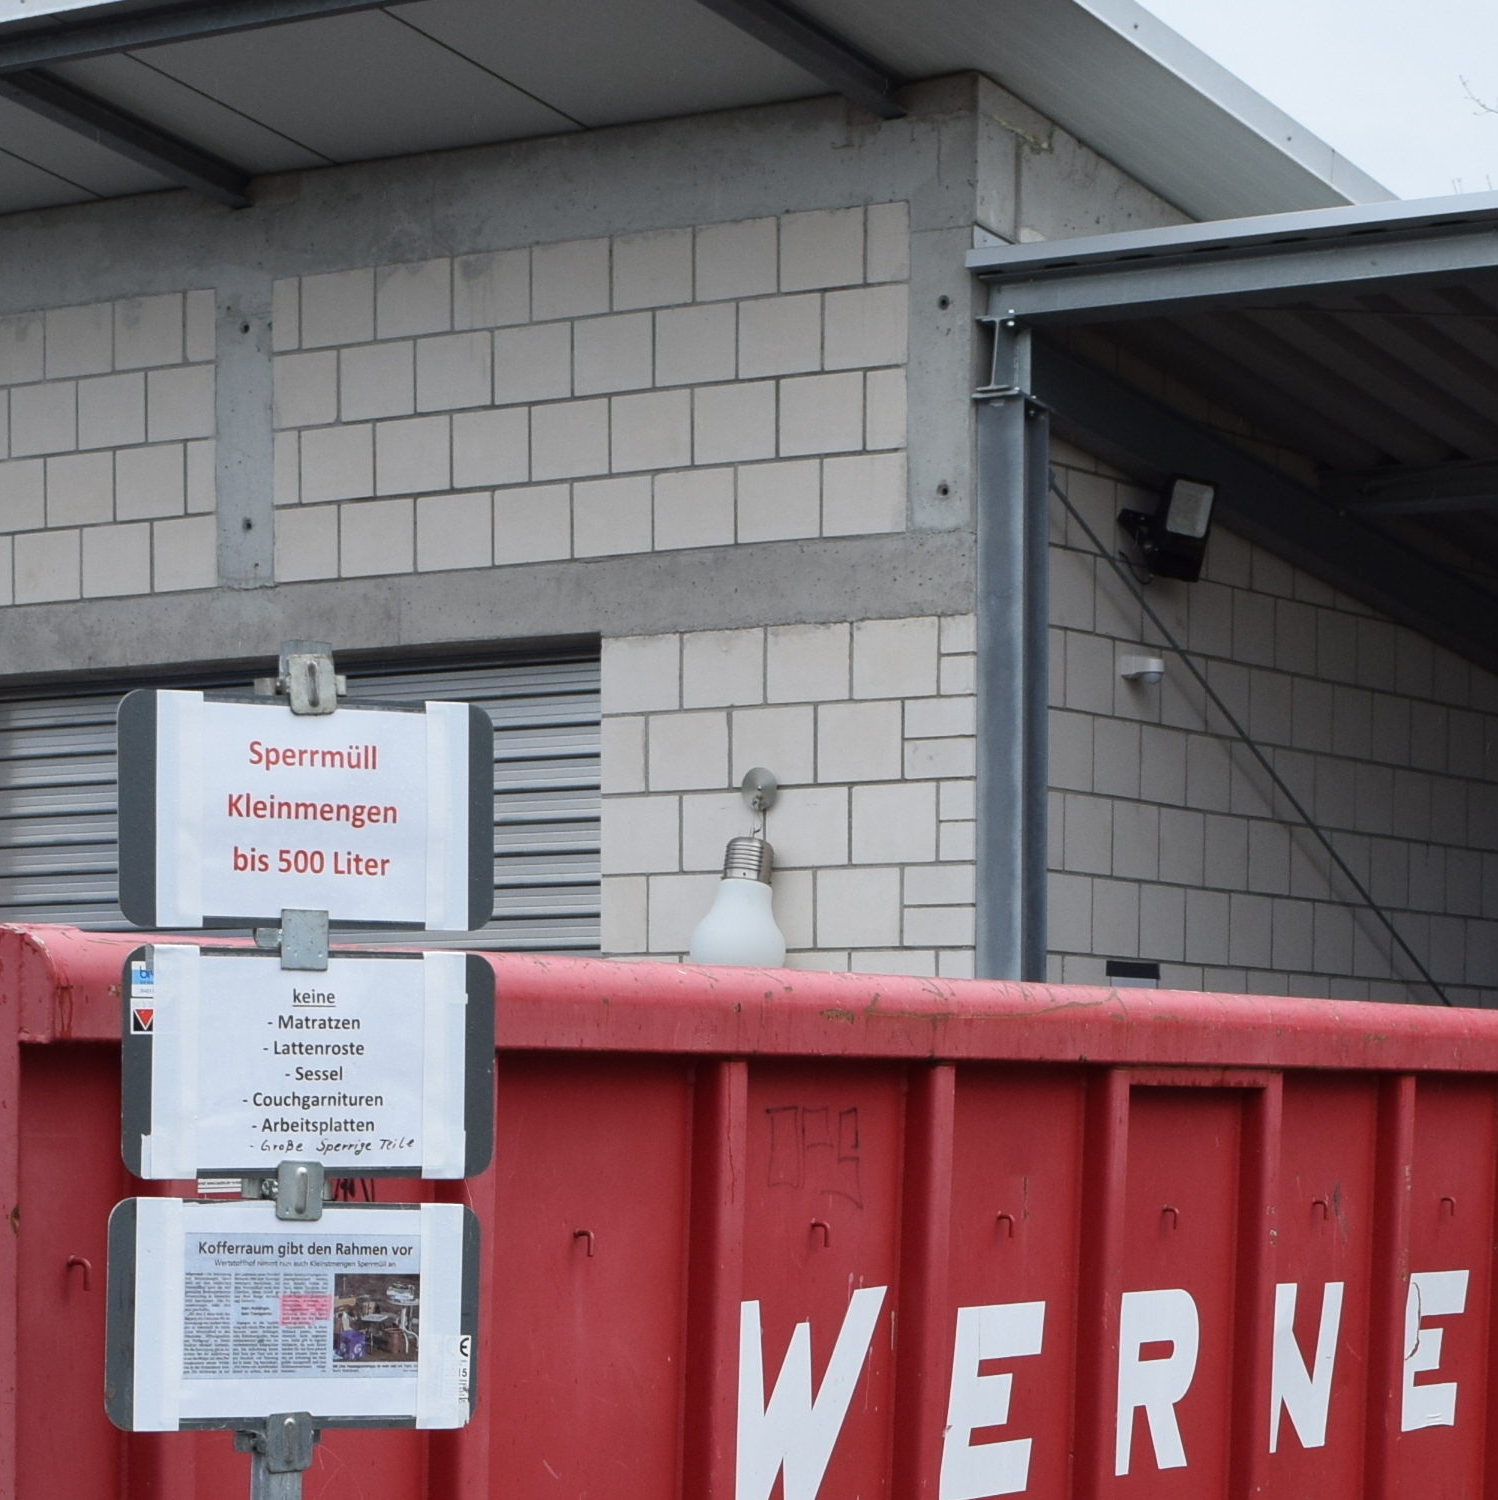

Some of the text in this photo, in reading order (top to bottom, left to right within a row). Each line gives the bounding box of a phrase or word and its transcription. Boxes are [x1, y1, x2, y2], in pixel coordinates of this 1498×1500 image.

[249, 740, 377, 770] Sperrmüll
[228, 793, 398, 829] Kleinmengen
[233, 847, 390, 877] bis 500 Liter
[292, 988, 336, 1005] keine
[278, 1014, 361, 1030] Matratzen
[273, 1040, 365, 1056] Lattenroste
[295, 1065, 343, 1082] Sessel
[252, 1092, 384, 1110] Couchgarnituren
[261, 1117, 375, 1135] Arbeitsplatten
[379, 1137, 415, 1150] Teile
[198, 1240, 413, 1258] Kofferraum gibt den Rahmen vor
[214, 1258, 255, 1268] Wertstoffhof
[357, 1260, 387, 1270] Sperrmüll
